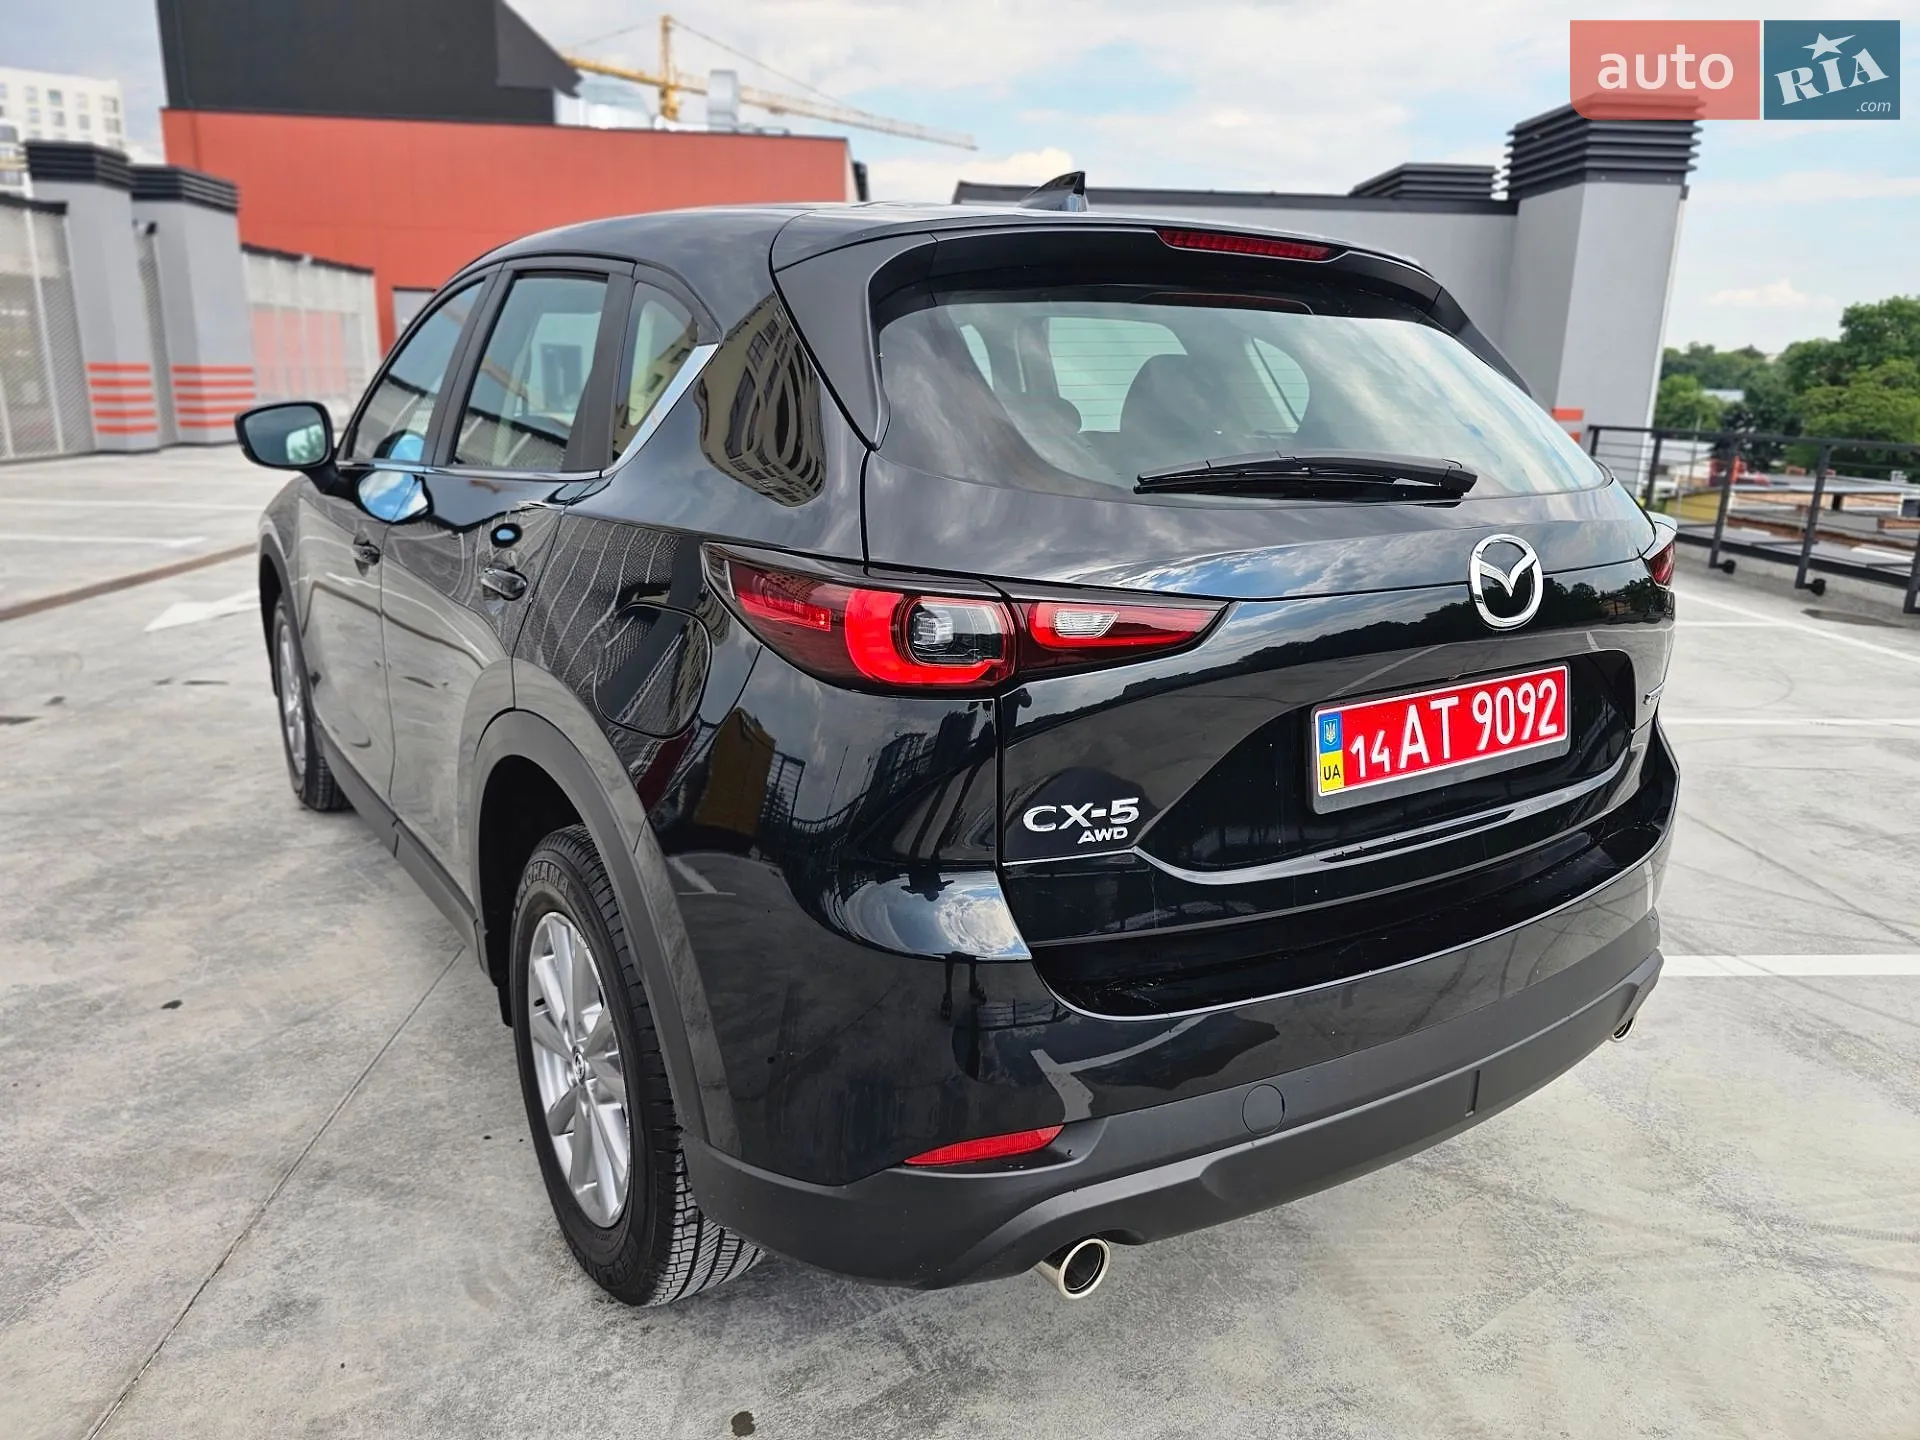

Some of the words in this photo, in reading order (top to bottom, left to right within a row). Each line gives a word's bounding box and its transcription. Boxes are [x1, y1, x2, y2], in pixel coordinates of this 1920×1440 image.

[1472, 678, 1558, 751] 9092
[1323, 764, 1341, 781] UA
[1023, 797, 1139, 832] CX-5
[1077, 826, 1128, 844] AWD
